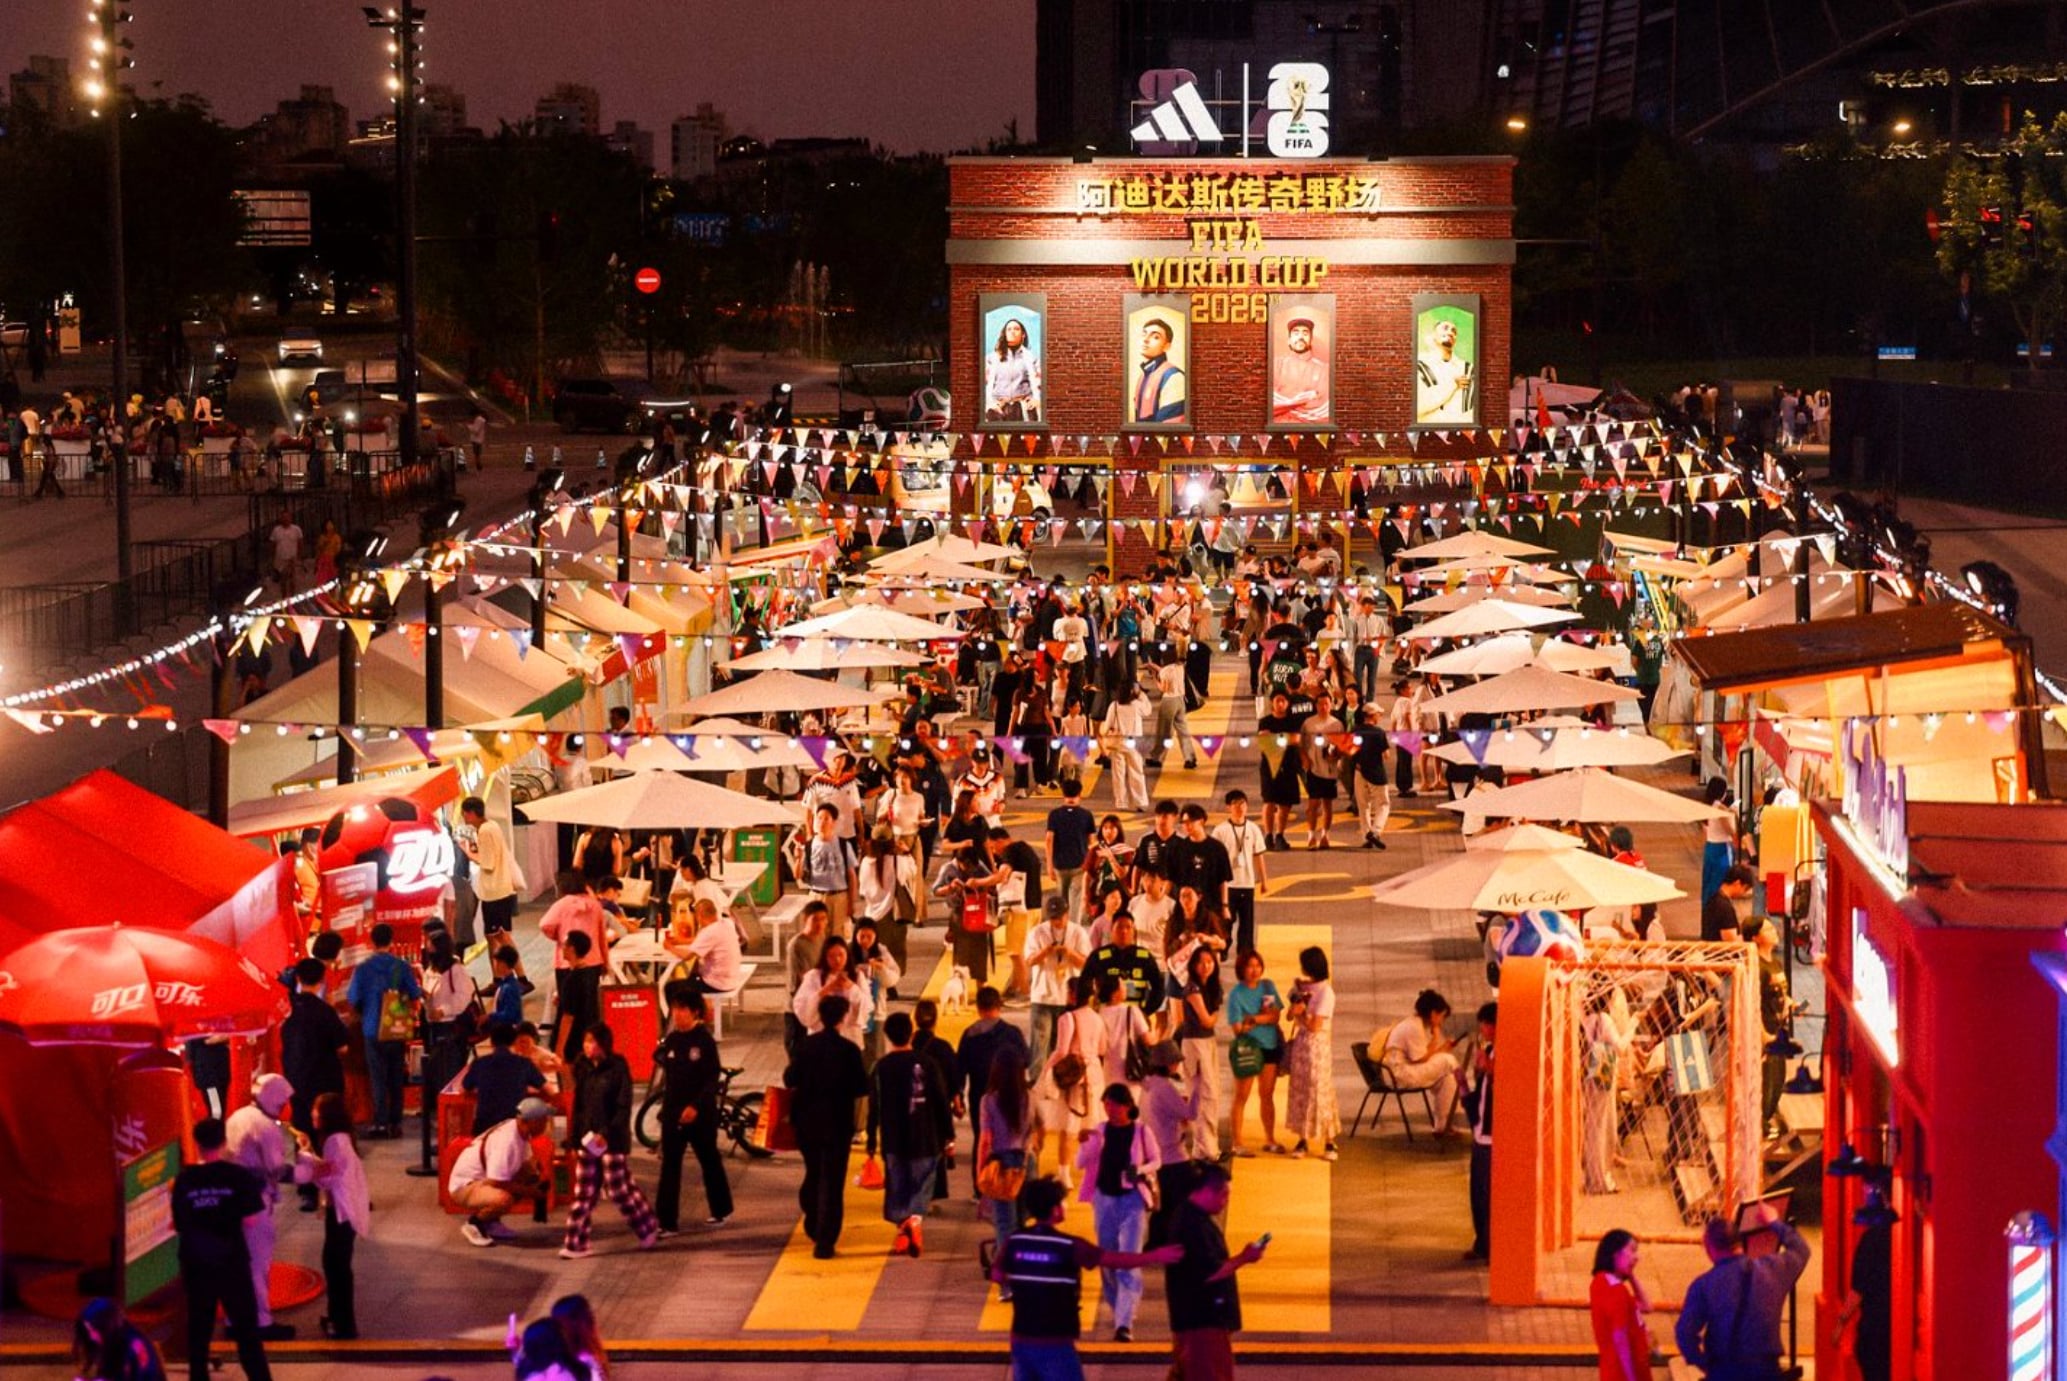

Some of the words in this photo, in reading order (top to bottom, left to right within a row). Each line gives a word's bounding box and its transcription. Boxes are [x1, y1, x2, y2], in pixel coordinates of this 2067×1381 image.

[1285, 138, 1312, 149] FIFA
[1077, 177, 1383, 213] 阿迪达斯传奇野场
[1190, 221, 1266, 252] FIFA
[1132, 258, 1250, 288] WORLD
[1260, 258, 1328, 288] CUP
[91, 982, 148, 1019] 可口
[154, 981, 206, 1007] 可乐
